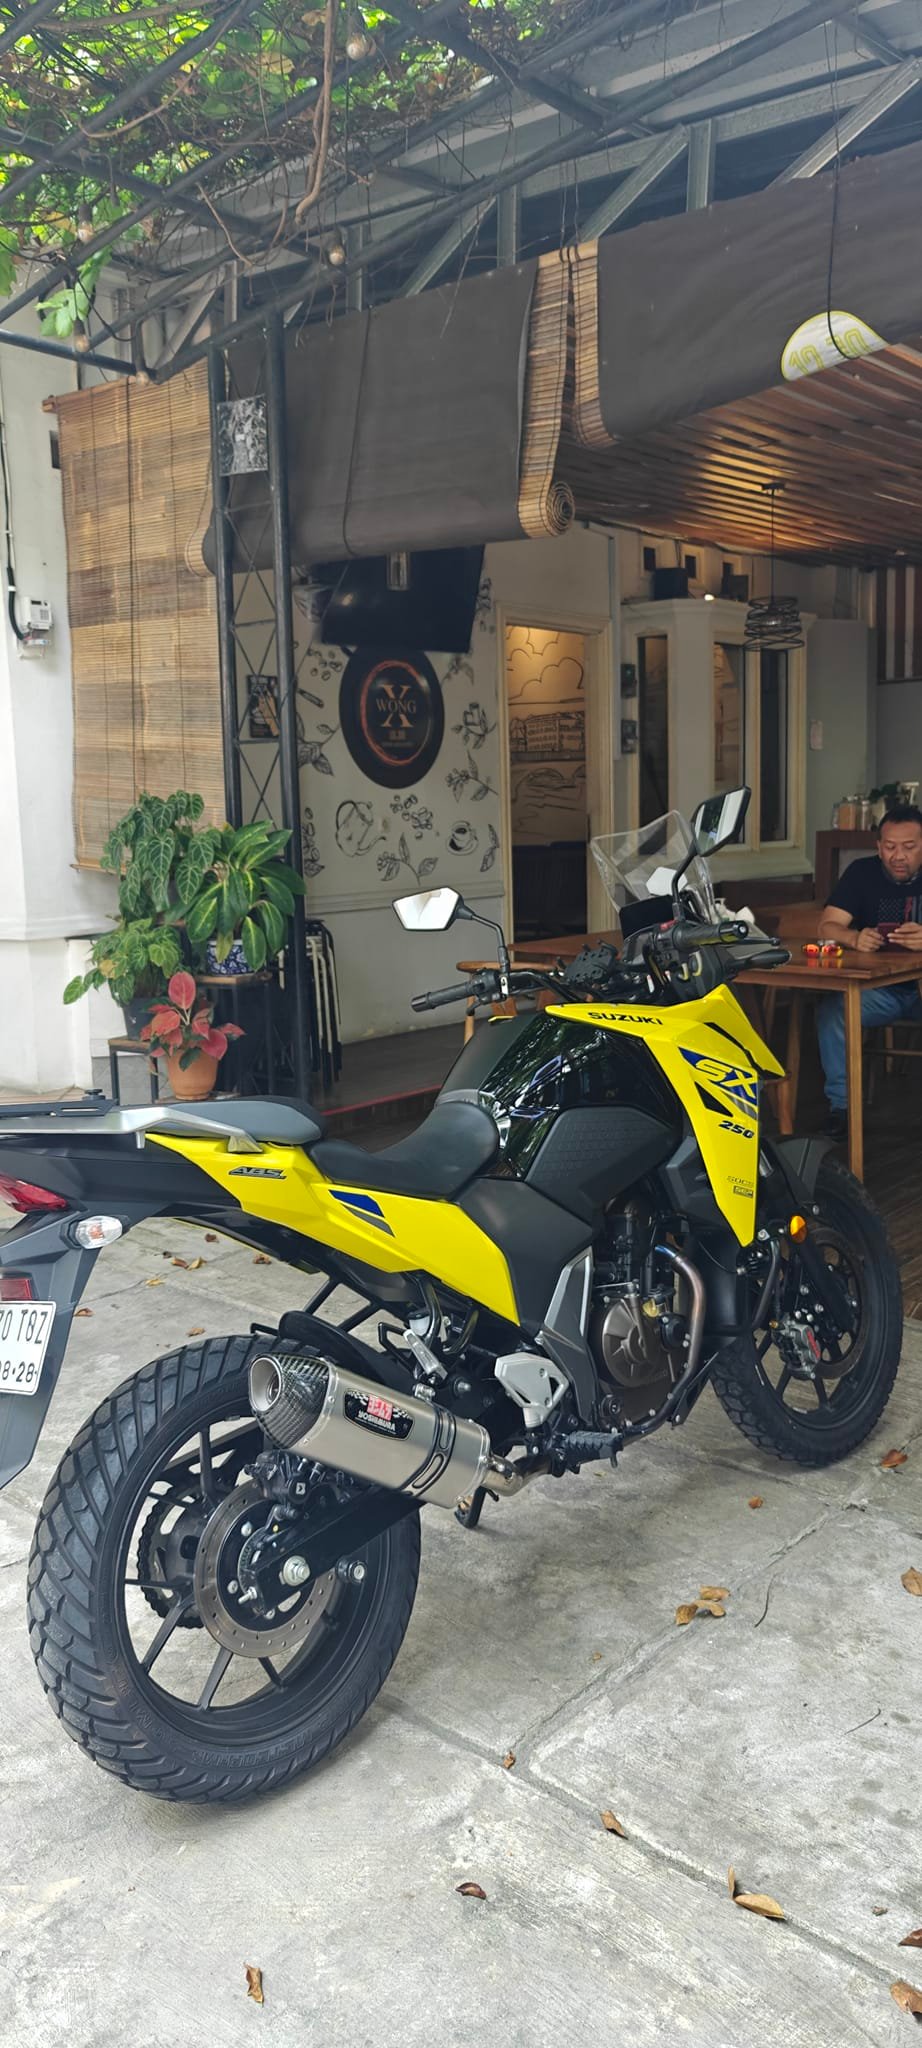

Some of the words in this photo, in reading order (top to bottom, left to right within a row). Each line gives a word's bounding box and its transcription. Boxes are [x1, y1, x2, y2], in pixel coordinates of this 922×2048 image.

[375, 698, 417, 713] WONG
[587, 1011, 663, 1025] SUZUKI
[695, 1058, 757, 1100] SX
[718, 1120, 755, 1139] 250
[231, 1166, 284, 1178] ABS
[17, 1308, 49, 1345] T8Z
